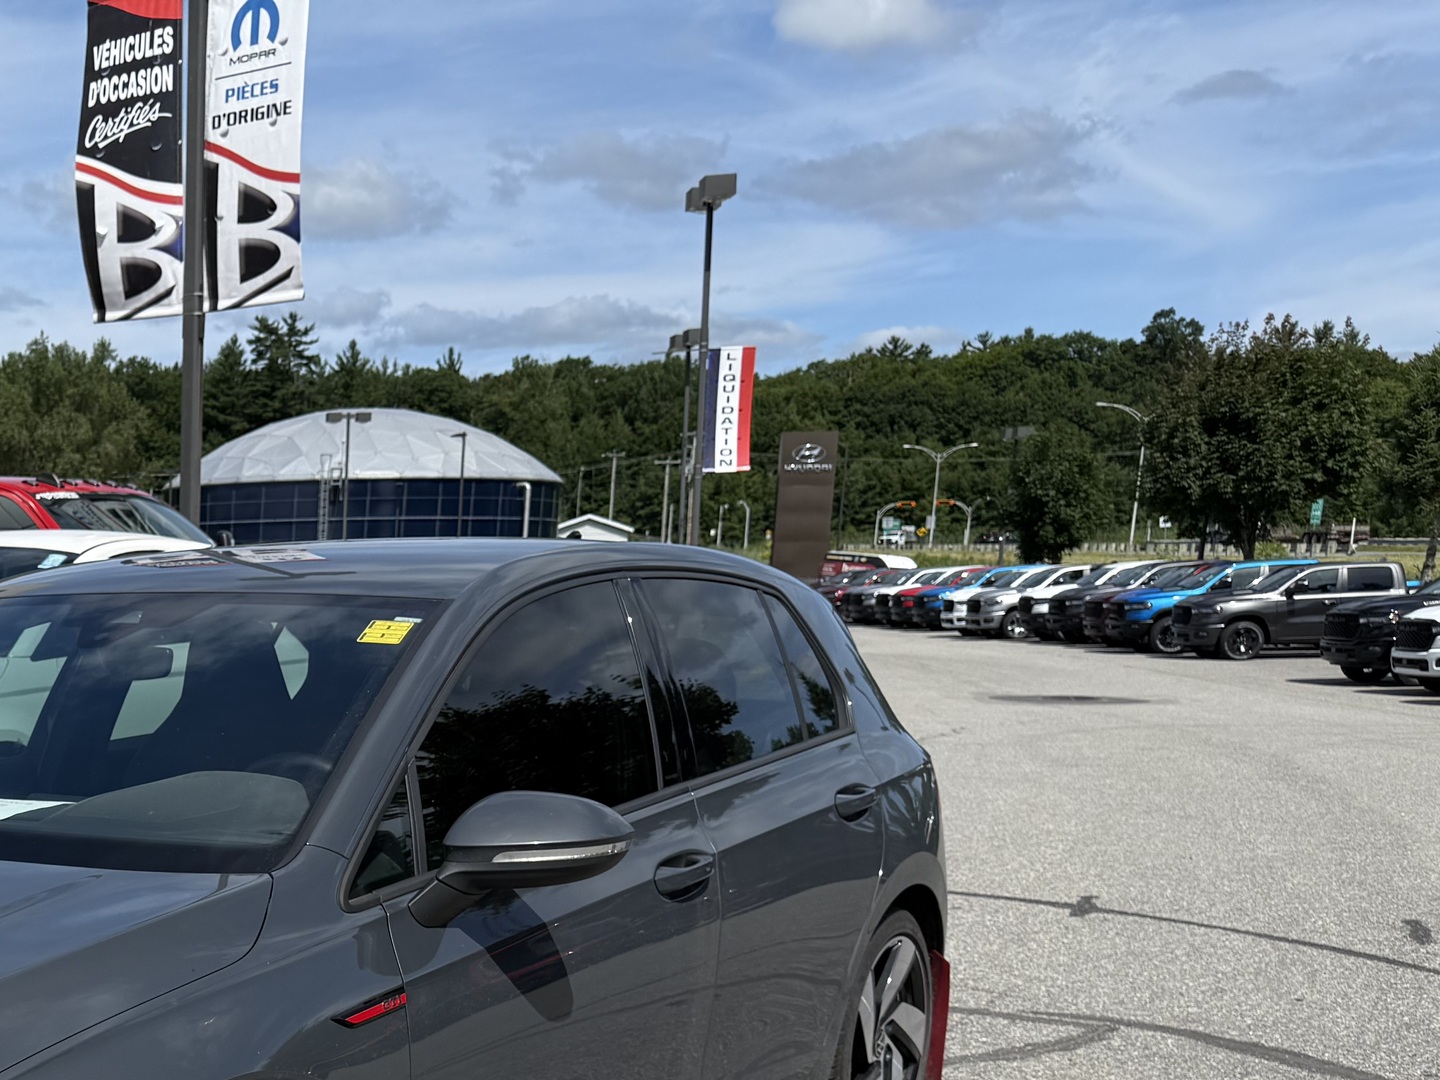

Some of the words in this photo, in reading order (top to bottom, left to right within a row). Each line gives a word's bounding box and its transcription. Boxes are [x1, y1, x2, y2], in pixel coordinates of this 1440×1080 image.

[92, 25, 174, 72] VÉHICULES
[228, 48, 277, 67] MOPAR
[87, 63, 173, 108] D'OCCASION
[224, 78, 279, 103] PIÈCES
[84, 98, 172, 149] Certifiés
[212, 99, 293, 130] D'ORIGINE
[719, 352, 737, 467] LIQUIDATION
